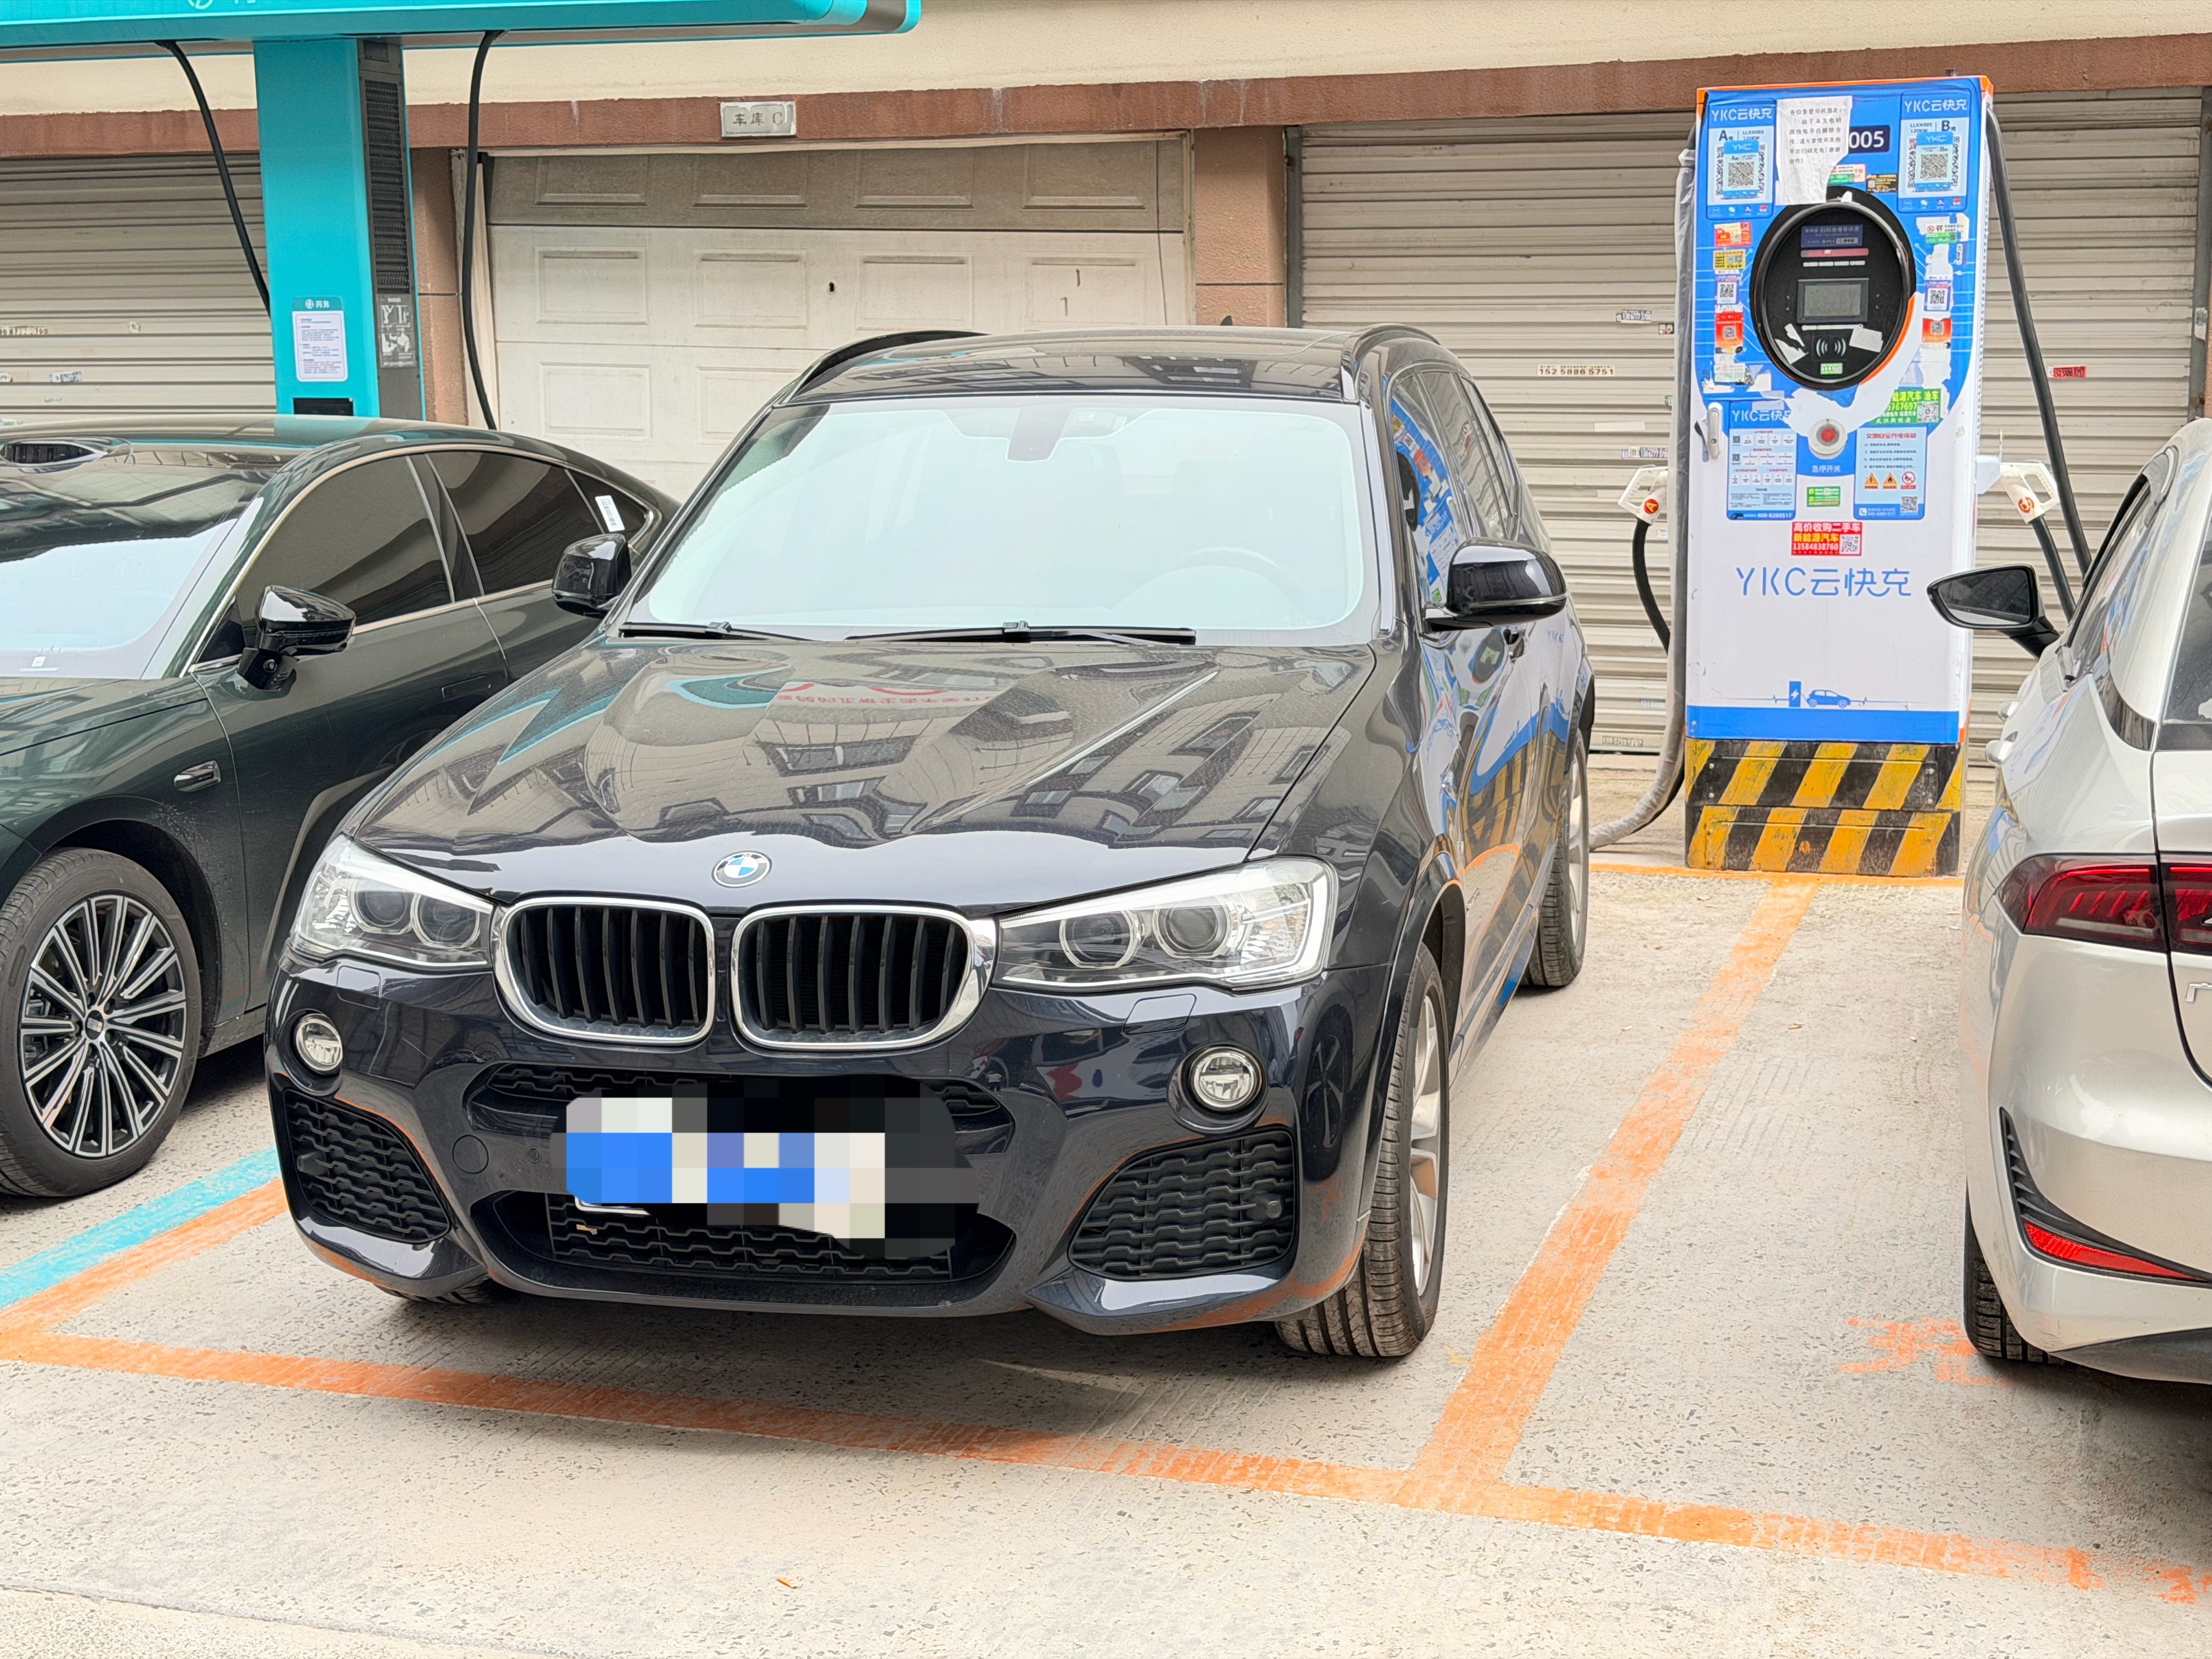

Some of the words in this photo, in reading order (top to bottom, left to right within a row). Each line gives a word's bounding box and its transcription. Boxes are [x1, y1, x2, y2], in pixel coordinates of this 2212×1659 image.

[1904, 99, 1967, 112] YKC云快充
[733, 112, 765, 126] 车库
[1712, 108, 1772, 122] YKC云快充
[1849, 131, 1884, 149] 005
[1812, 465, 1841, 473] 急停开关
[1646, 502, 1657, 512] A
[1793, 522, 1861, 533] 高价收购二手车
[1793, 533, 1839, 543] 新能源汽车
[1736, 567, 1911, 597] YKC云快充
